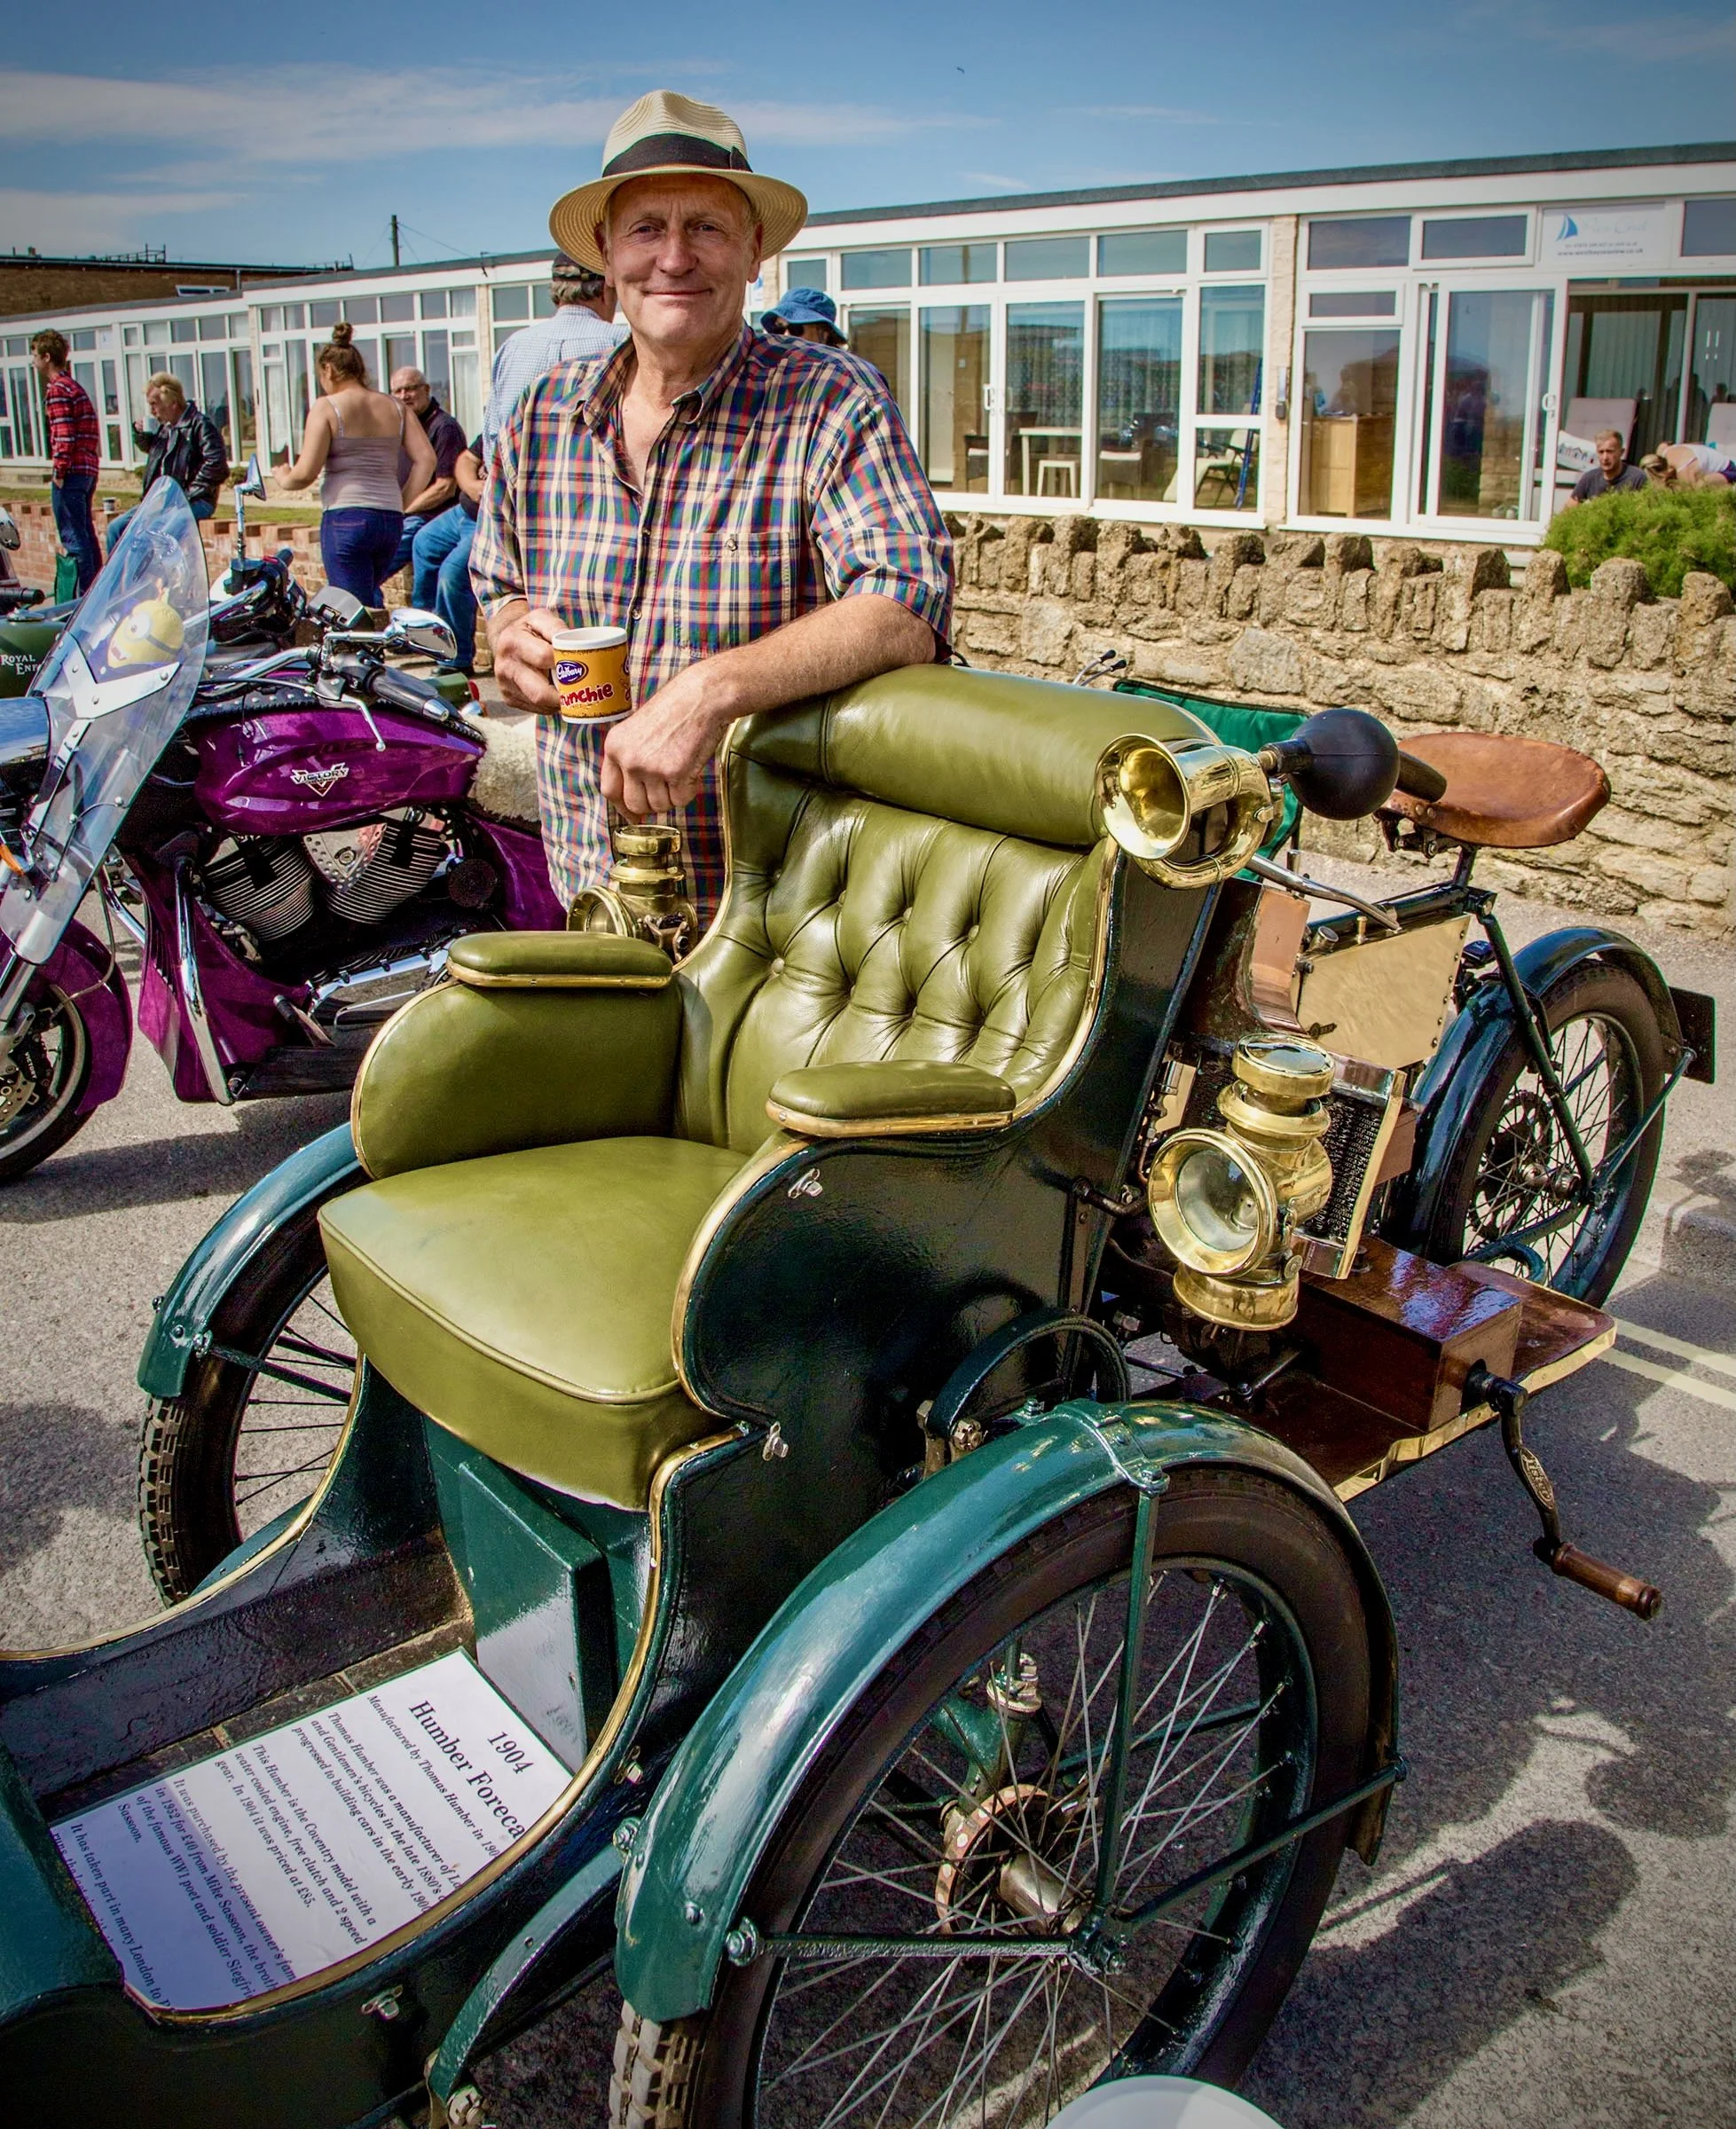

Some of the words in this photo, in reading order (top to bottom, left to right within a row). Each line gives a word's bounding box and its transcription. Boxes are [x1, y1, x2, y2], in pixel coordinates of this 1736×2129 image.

[0, 655, 35, 666] ROYAL
[556, 664, 583, 680] Cadbury
[560, 684, 614, 706] runchie
[294, 769, 347, 782] VICTORY
[487, 1731, 533, 1774] 1904
[214, 1760, 234, 1782] gear.
[234, 1752, 255, 1776] water
[408, 1700, 473, 1771] Humber
[465, 1770, 532, 1839] Foreca
[173, 1778, 185, 1787] It
[366, 1694, 416, 1749] Manufactured
[409, 1748, 421, 1759] by
[418, 1759, 447, 1794] Thomas
[443, 1793, 475, 1827] Humber
[471, 1827, 483, 1840] in
[482, 1841, 501, 1857] 190
[136, 1795, 151, 1805] of
[154, 1787, 166, 1798] in
[177, 1788, 193, 1807] was
[232, 1784, 244, 1795] In
[250, 1777, 276, 1805] cooled
[310, 1720, 330, 1737] and
[357, 1783, 386, 1819] bicycles
[381, 1818, 394, 1829] in
[389, 1829, 405, 1845] the
[401, 1844, 420, 1865] late
[327, 1711, 354, 1744] Thomas
[350, 1743, 379, 1775] Humber
[373, 1777, 392, 1795] was
[392, 1802, 444, 1863] manufacturer
[439, 1864, 456, 1874] of
[141, 1805, 155, 1820] the
[161, 1798, 180, 1819] 1952
[240, 1796, 260, 1817] 1904
[290, 1726, 332, 1770] progressed
[323, 1770, 334, 1779] to
[330, 1778, 362, 1817] building
[357, 1816, 376, 1836] cars
[371, 1835, 383, 1848] in
[379, 1848, 396, 1864] the
[391, 1865, 413, 1889] early
[70, 1823, 82, 1834] It
[117, 1803, 142, 1843] Sassoon.
[169, 1819, 186, 1833] for
[185, 1806, 224, 1854] purchased
[252, 1816, 264, 1826] it
[252, 1744, 270, 1764] This
[264, 1764, 292, 1797] Humber
[287, 1797, 298, 1808] is
[293, 1807, 308, 1823] the
[303, 1823, 334, 1863] Coventry
[329, 1863, 358, 1892] model
[350, 1893, 373, 1916] with
[268, 1805, 292, 1838] engine,
[75, 1832, 90, 1852] has
[146, 1821, 174, 1856] famous
[180, 1834, 199, 1850] £40
[257, 1826, 274, 1845] was
[287, 1837, 306, 1856] free
[82, 1851, 103, 1880] taken
[169, 1854, 190, 1879] WW1
[187, 1850, 208, 1874] from
[216, 1852, 229, 1866] by
[266, 1844, 297, 1875] priced
[223, 1866, 238, 1882] the
[288, 1875, 302, 1887] at
[301, 1857, 327, 1887] clutch
[93, 1880, 116, 1903] part
[178, 1880, 200, 1901] poet
[203, 1874, 224, 1899] Mike
[295, 1887, 315, 1907] £85.
[321, 1887, 343, 1907] and
[107, 1902, 121, 1915] in
[193, 1902, 215, 1922] and
[230, 1883, 262, 1920] present
[334, 1906, 348, 1915] 2
[114, 1916, 135, 1944] many
[217, 1898, 246, 1944] Sassoon,
[339, 1915, 367, 1944] speed
[205, 1923, 232, 1958] soldier
[242, 1944, 259, 1961] the
[129, 1944, 154, 1987] London
[148, 1986, 161, 2000] to
